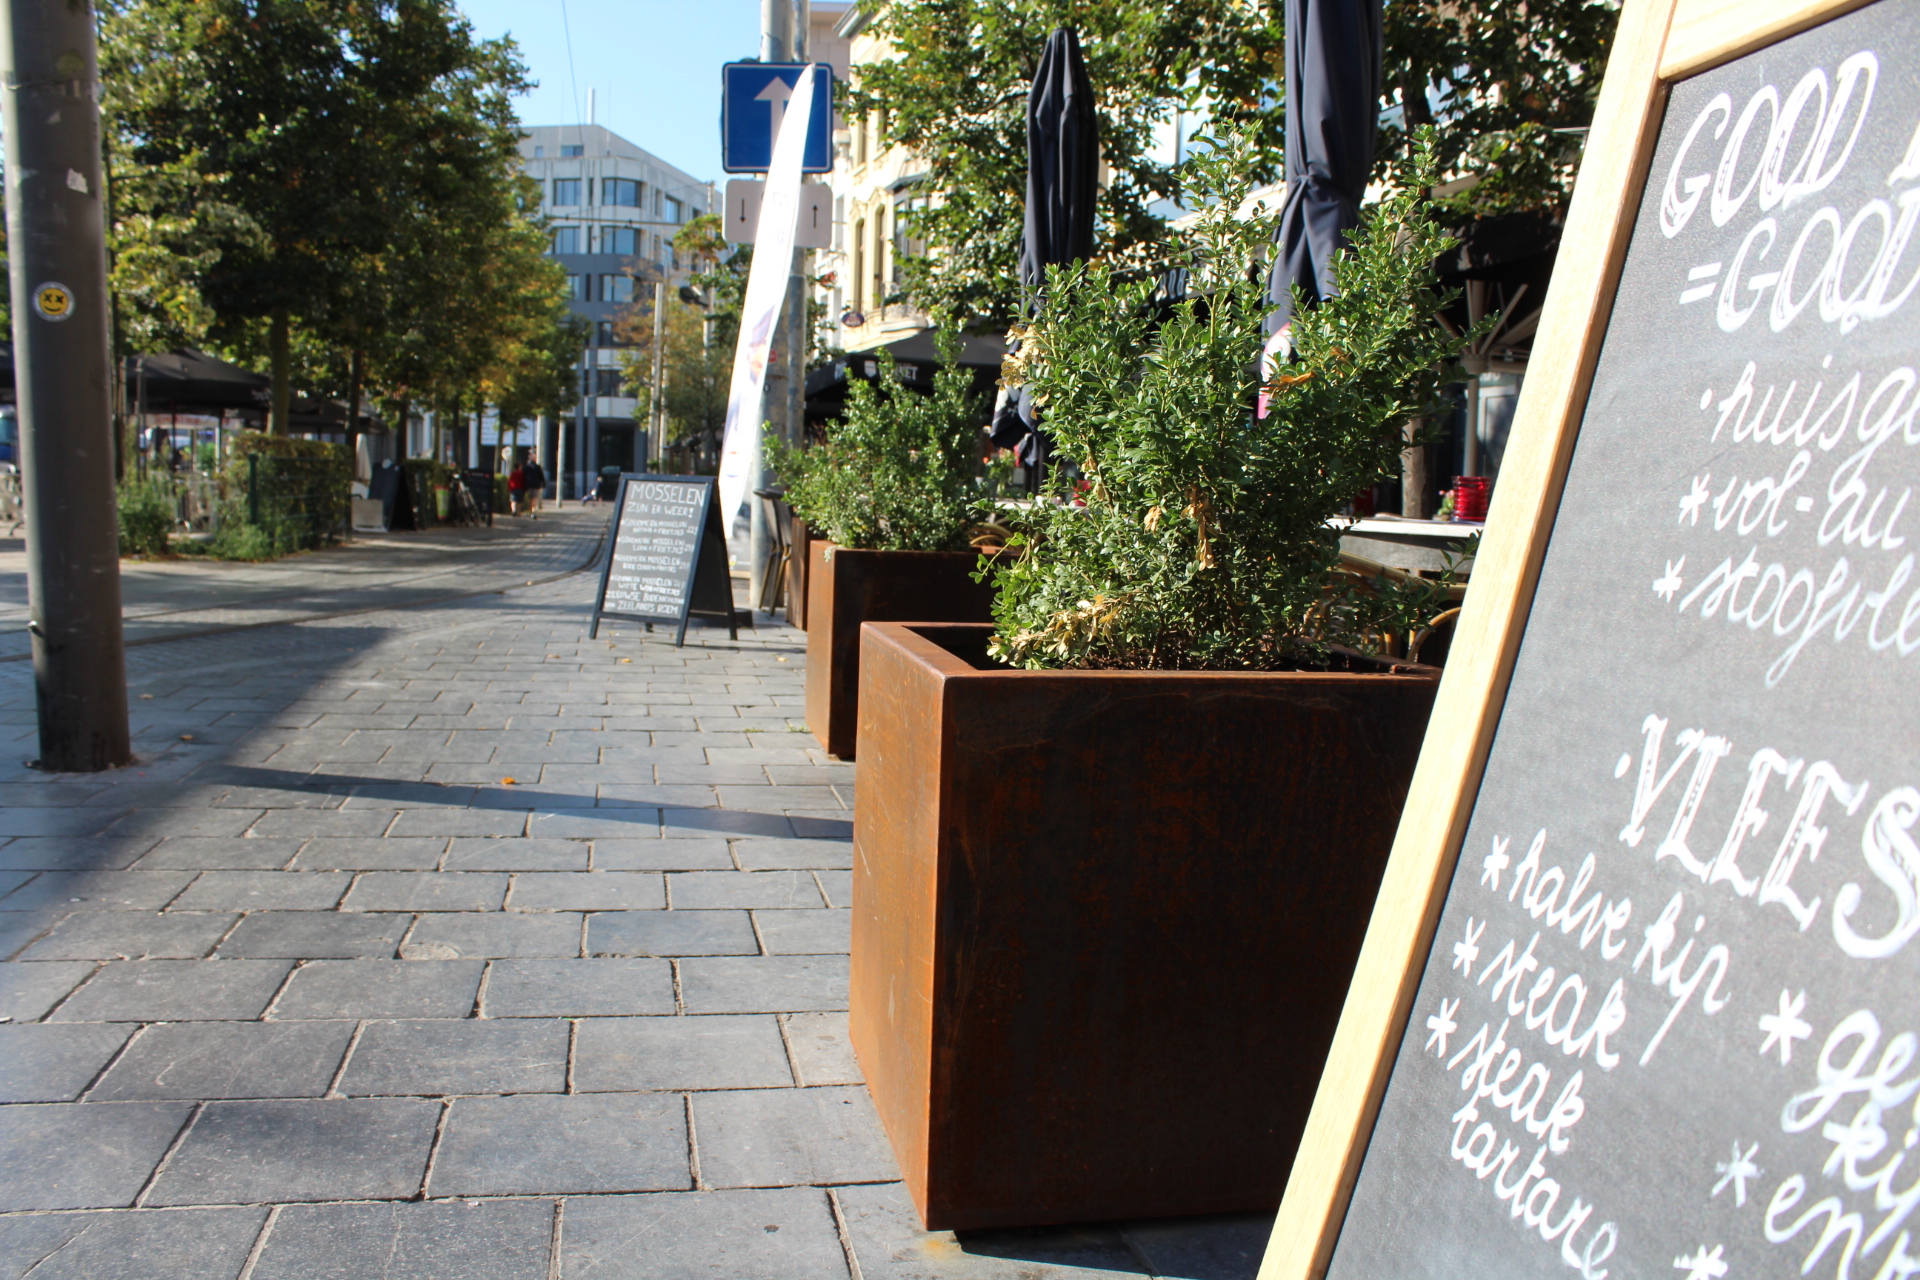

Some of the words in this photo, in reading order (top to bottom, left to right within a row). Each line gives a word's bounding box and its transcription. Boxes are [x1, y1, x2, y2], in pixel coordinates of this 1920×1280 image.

[1659, 49, 1879, 239] GOOD
[631, 483, 706, 508] MOSSELEN
[1477, 931, 1626, 1072] steak
[1508, 827, 1632, 961] halve
[1632, 891, 1732, 1067] kip
[1447, 1017, 1585, 1155] steak
[1450, 1095, 1619, 1280] tartare
